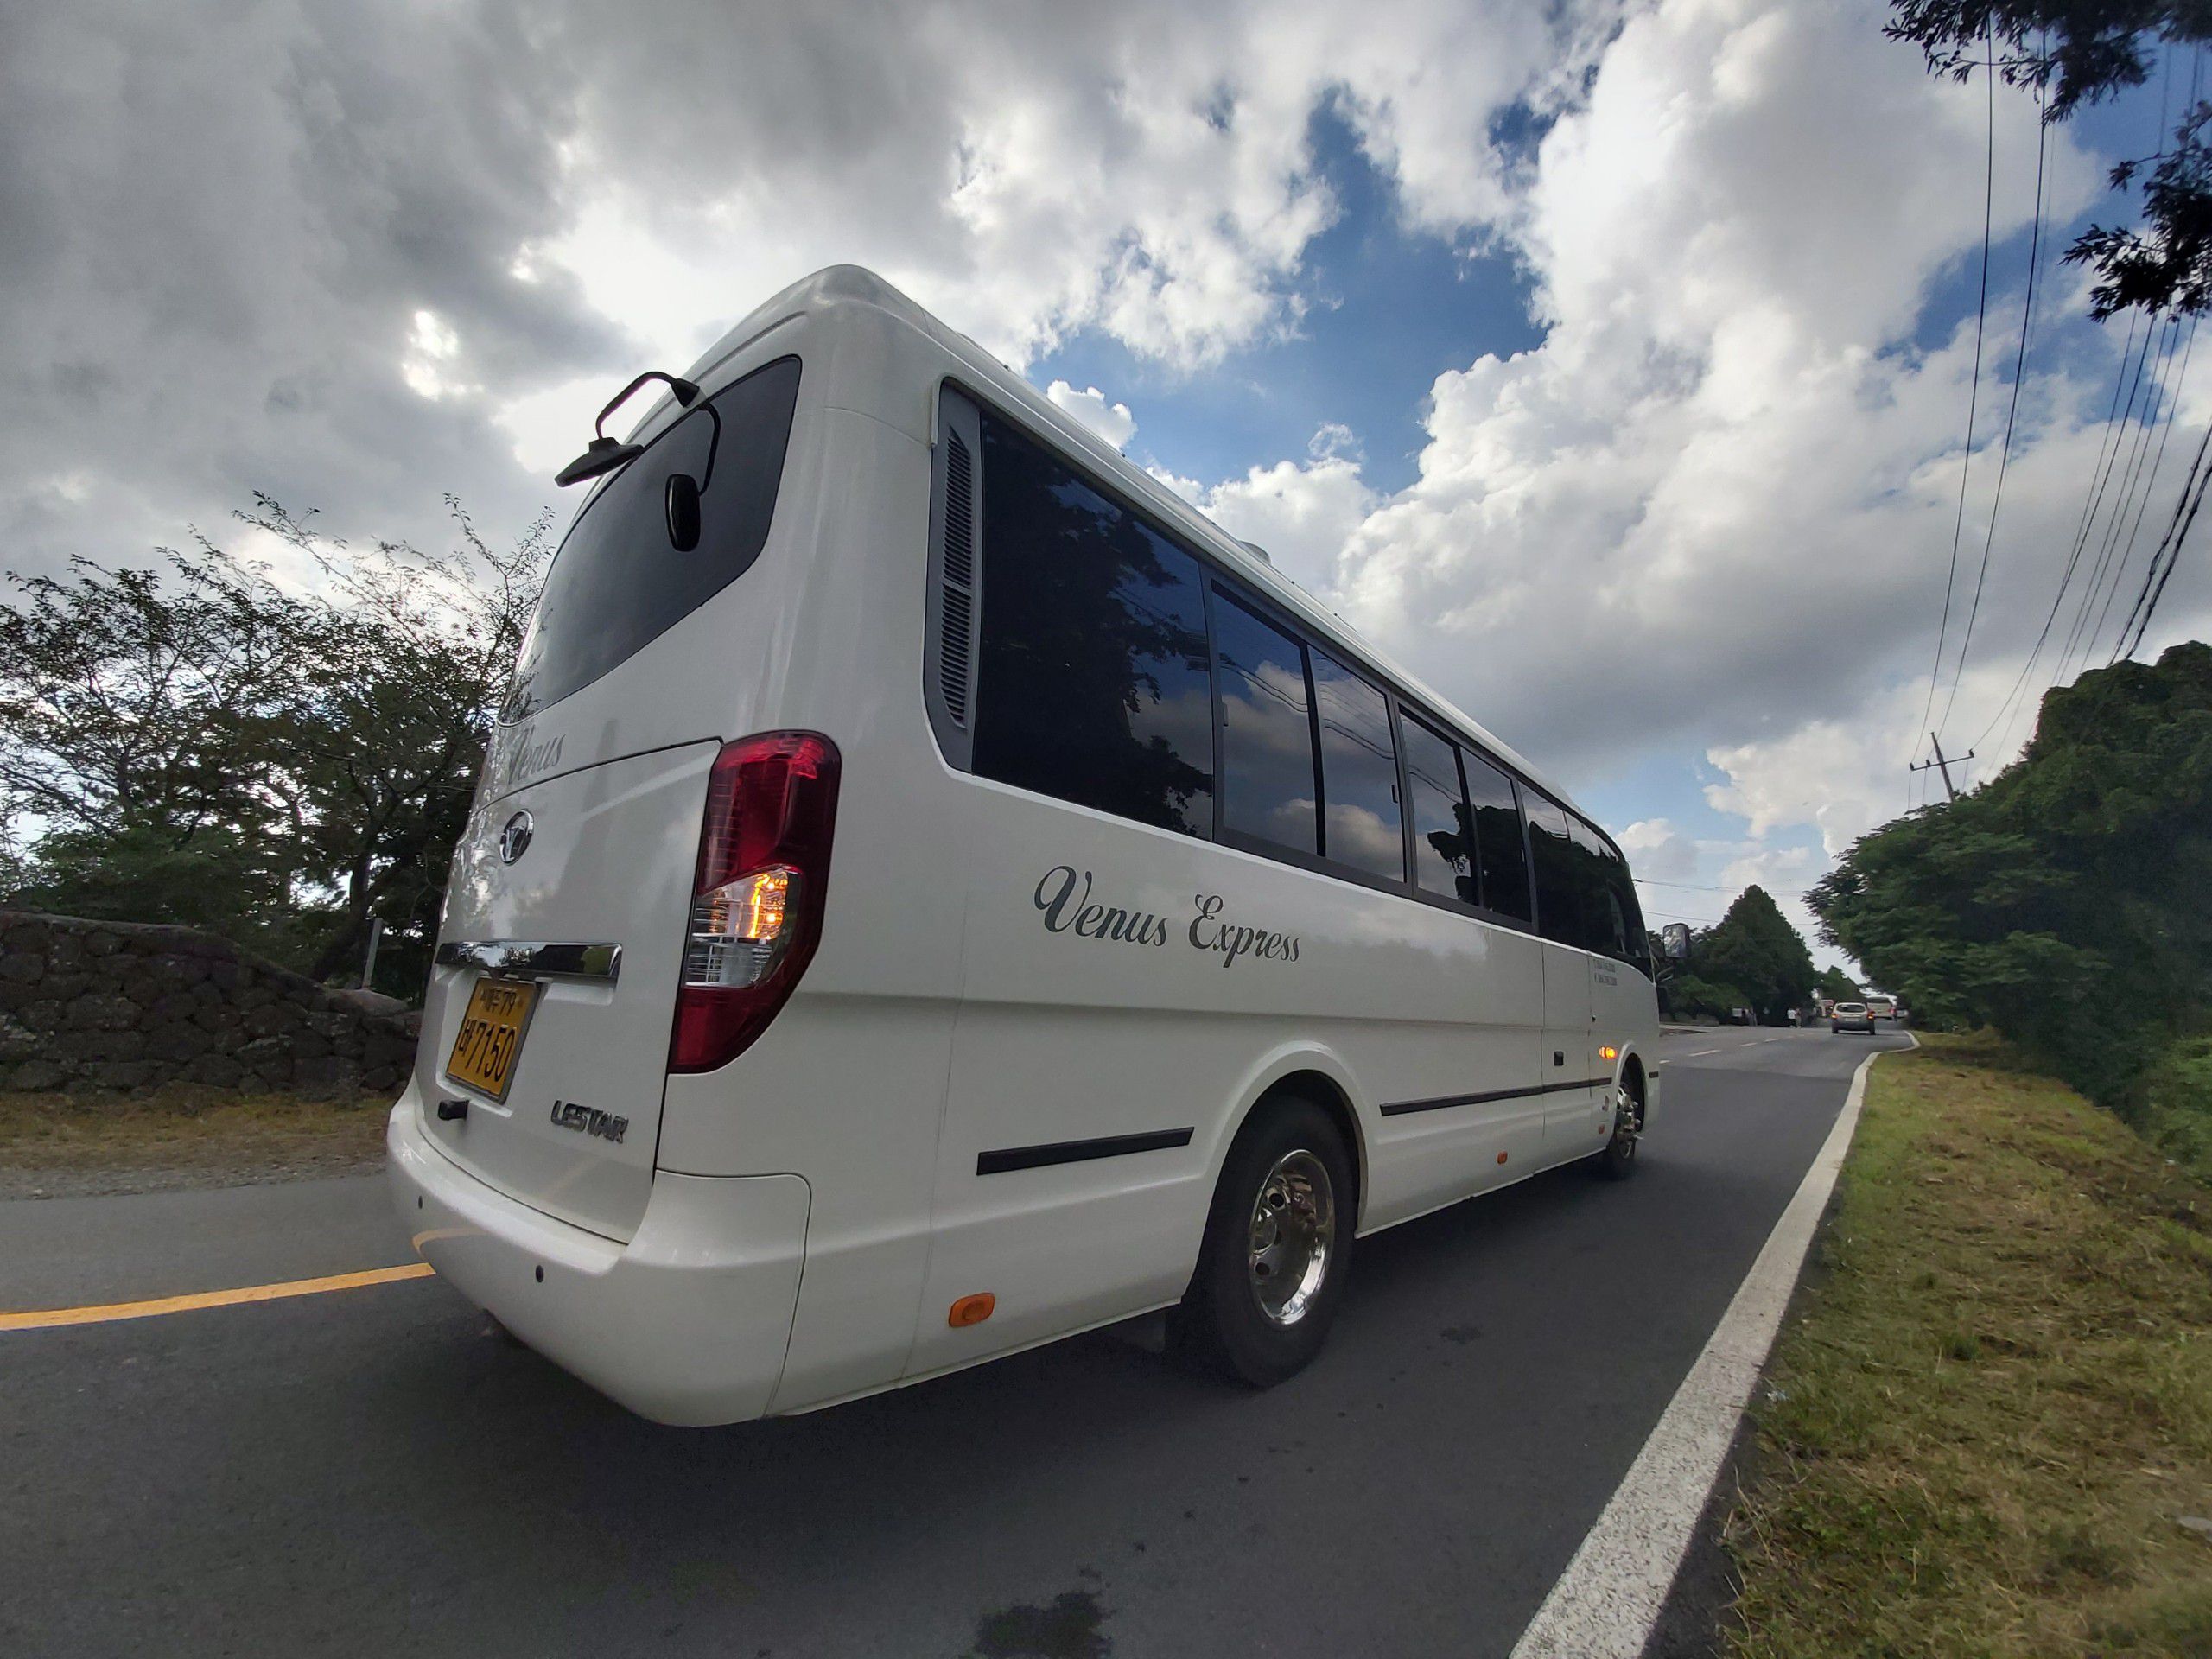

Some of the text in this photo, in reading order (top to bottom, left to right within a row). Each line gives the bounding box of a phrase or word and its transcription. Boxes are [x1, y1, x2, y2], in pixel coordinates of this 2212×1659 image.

[1034, 865, 1300, 969] Venus Express
[550, 1100, 629, 1144] LESTAR
